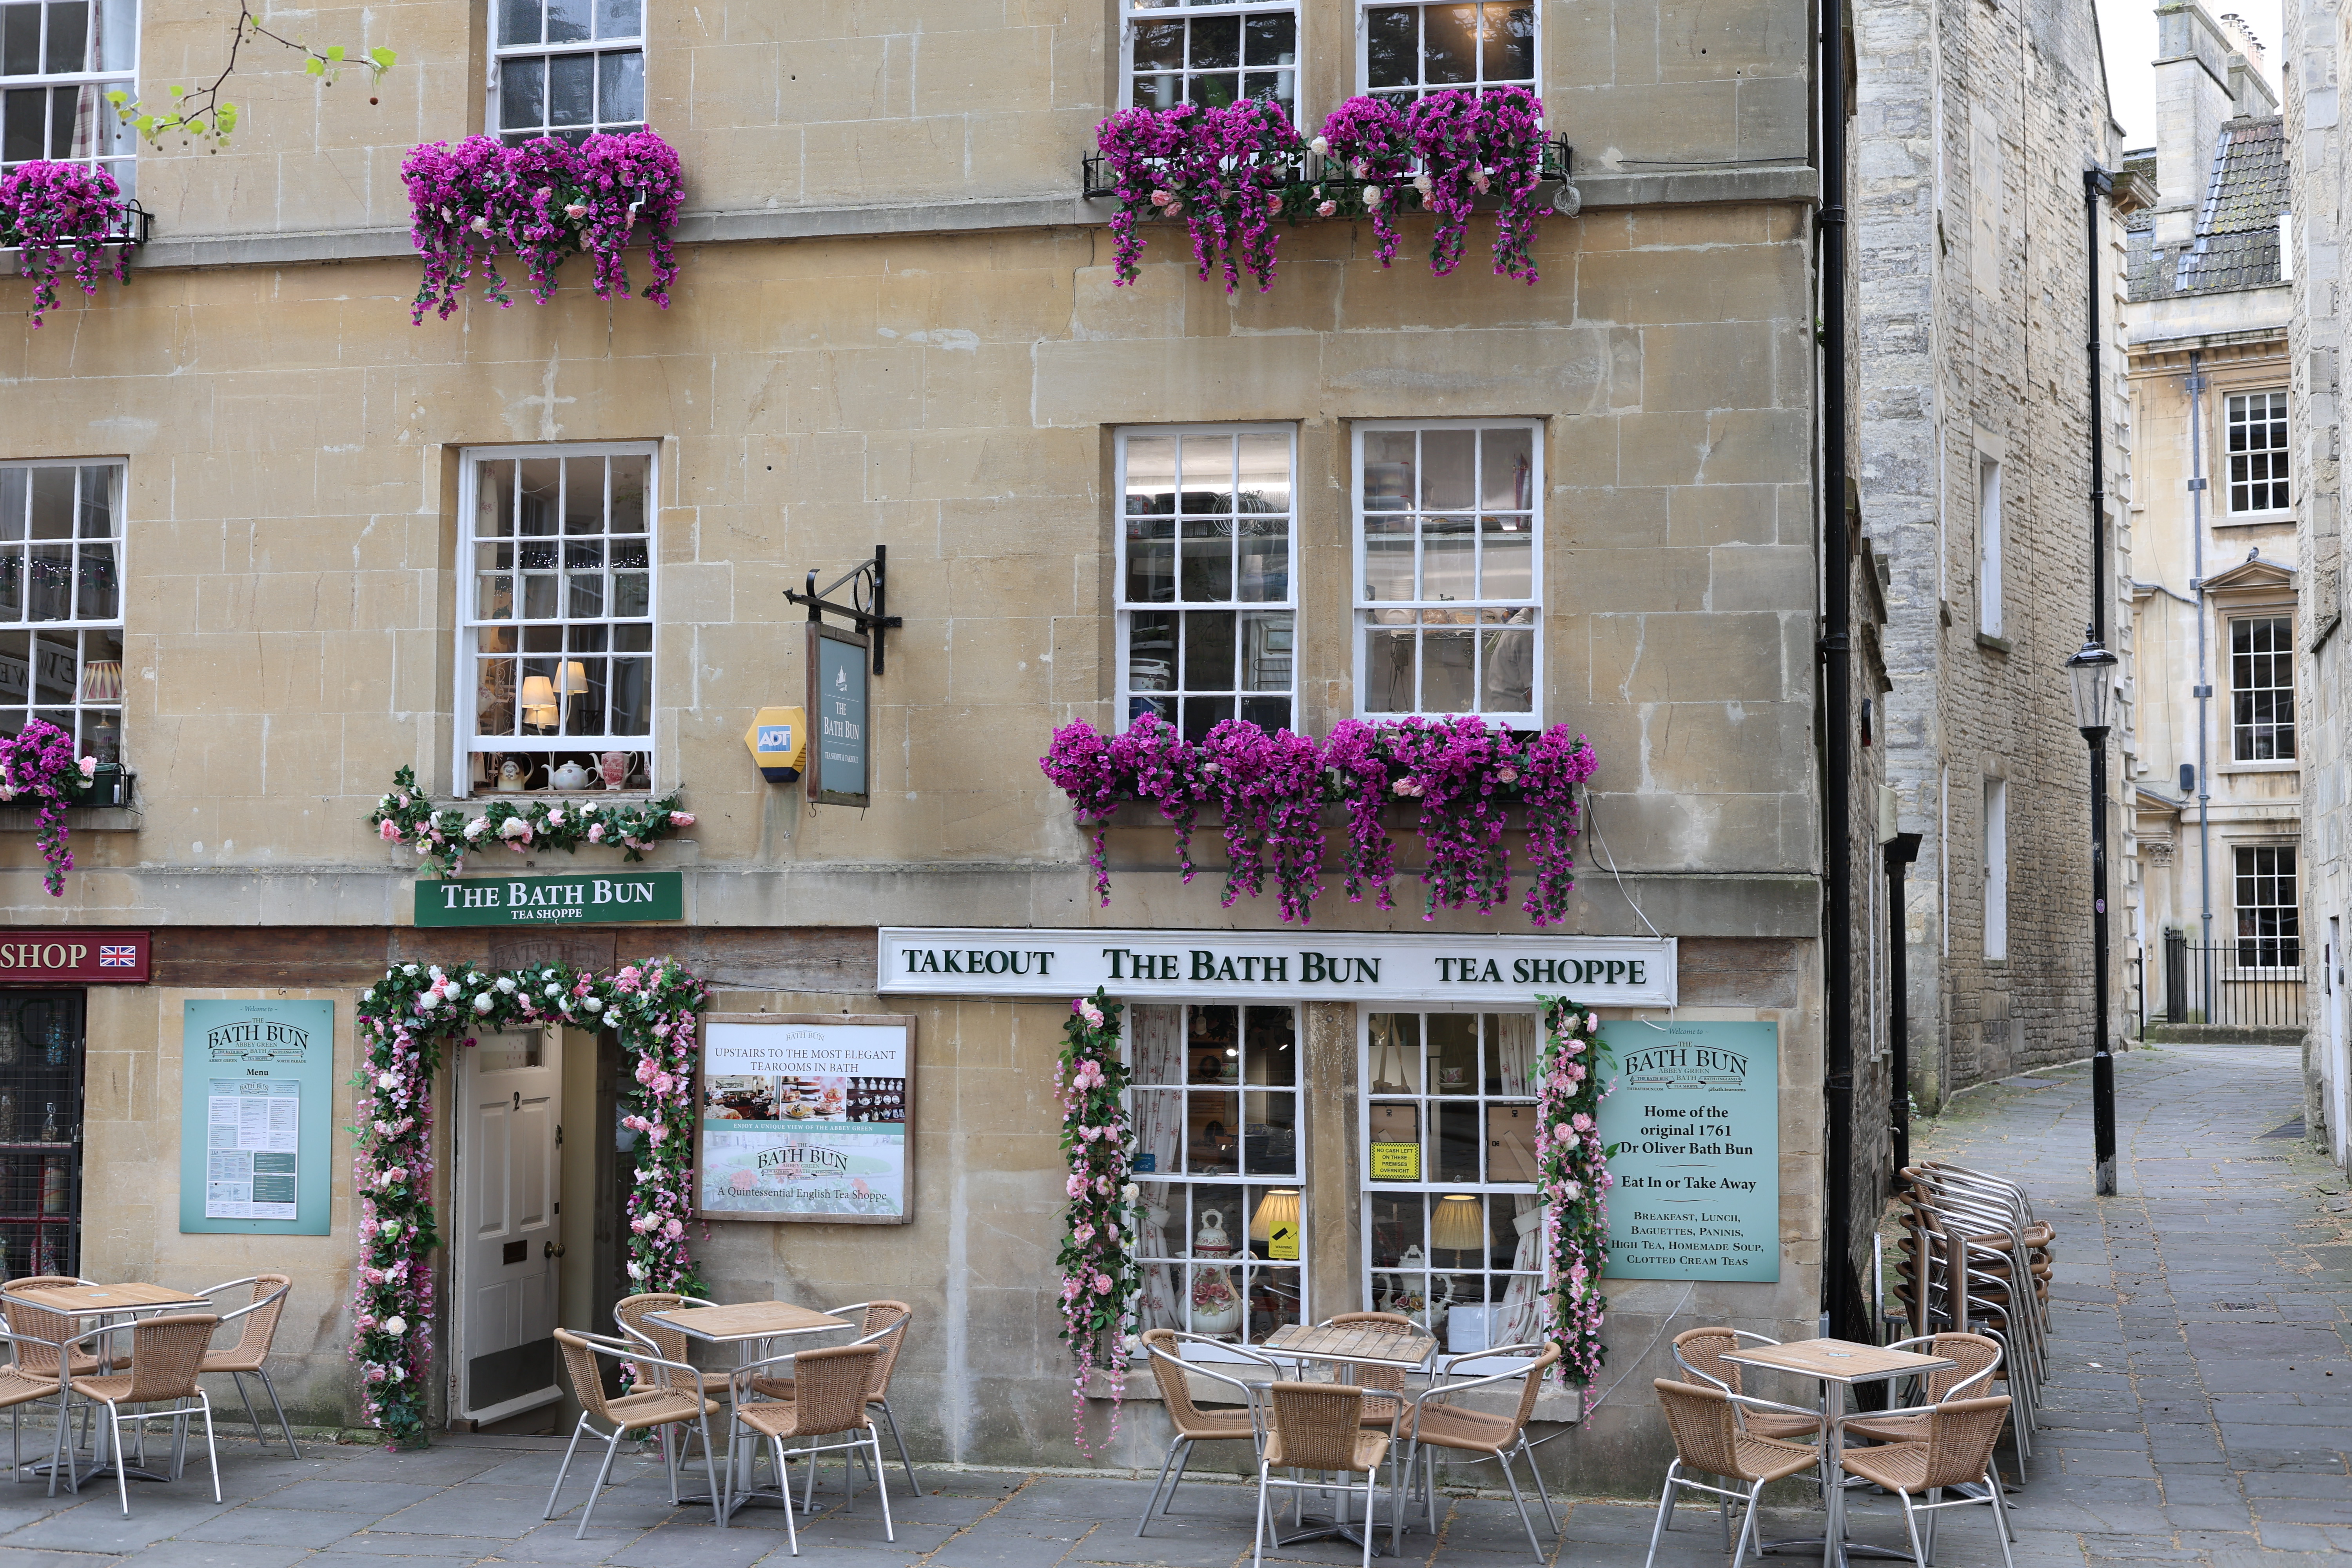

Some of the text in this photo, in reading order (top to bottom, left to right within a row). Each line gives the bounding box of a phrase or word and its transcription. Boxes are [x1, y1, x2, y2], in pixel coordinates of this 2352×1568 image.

[836, 702, 846, 715] THE
[824, 717, 859, 740] BATH BUN
[759, 731, 789, 746] ADT
[831, 753, 842, 762] SHOPPE
[845, 755, 858, 764] TAKEOUT
[441, 880, 655, 908] THE BATH BUN
[511, 909, 583, 919] TEA SHOPPE
[0, 944, 87, 968] SHOP
[493, 944, 611, 970] BATH BUN
[902, 949, 1647, 984] TAKEOUT THE BATH BUN TEA SHOPPE
[207, 1025, 309, 1050] BATH BUN
[786, 1032, 824, 1041] BATH BUN
[715, 1047, 896, 1060] UPSTAIRS TO THE MOST ELEGANT
[750, 1062, 858, 1073] TEAROOMS IN BATH
[1625, 1049, 1747, 1077] BATH BUN
[513, 1091, 520, 1110] 2
[1644, 1105, 1728, 1118] Home of the
[1641, 1124, 1731, 1139] original 1761
[1620, 1142, 1753, 1155] Dr Oliver Bath Bun
[758, 1149, 848, 1171] BATH BUN
[1621, 1176, 1757, 1192] Eat In or Take Away
[718, 1186, 887, 1202] A Quintessential English Tea Shoppe
[1634, 1212, 1740, 1223] BREAKFAST, LUNCH,
[1631, 1226, 1744, 1237] BAGUETTES, PANINIS,
[1612, 1240, 1764, 1253] HIGH TEA, HOMEMADE SOUP,
[1627, 1254, 1748, 1266] CLOTTED CREAM TEAS
